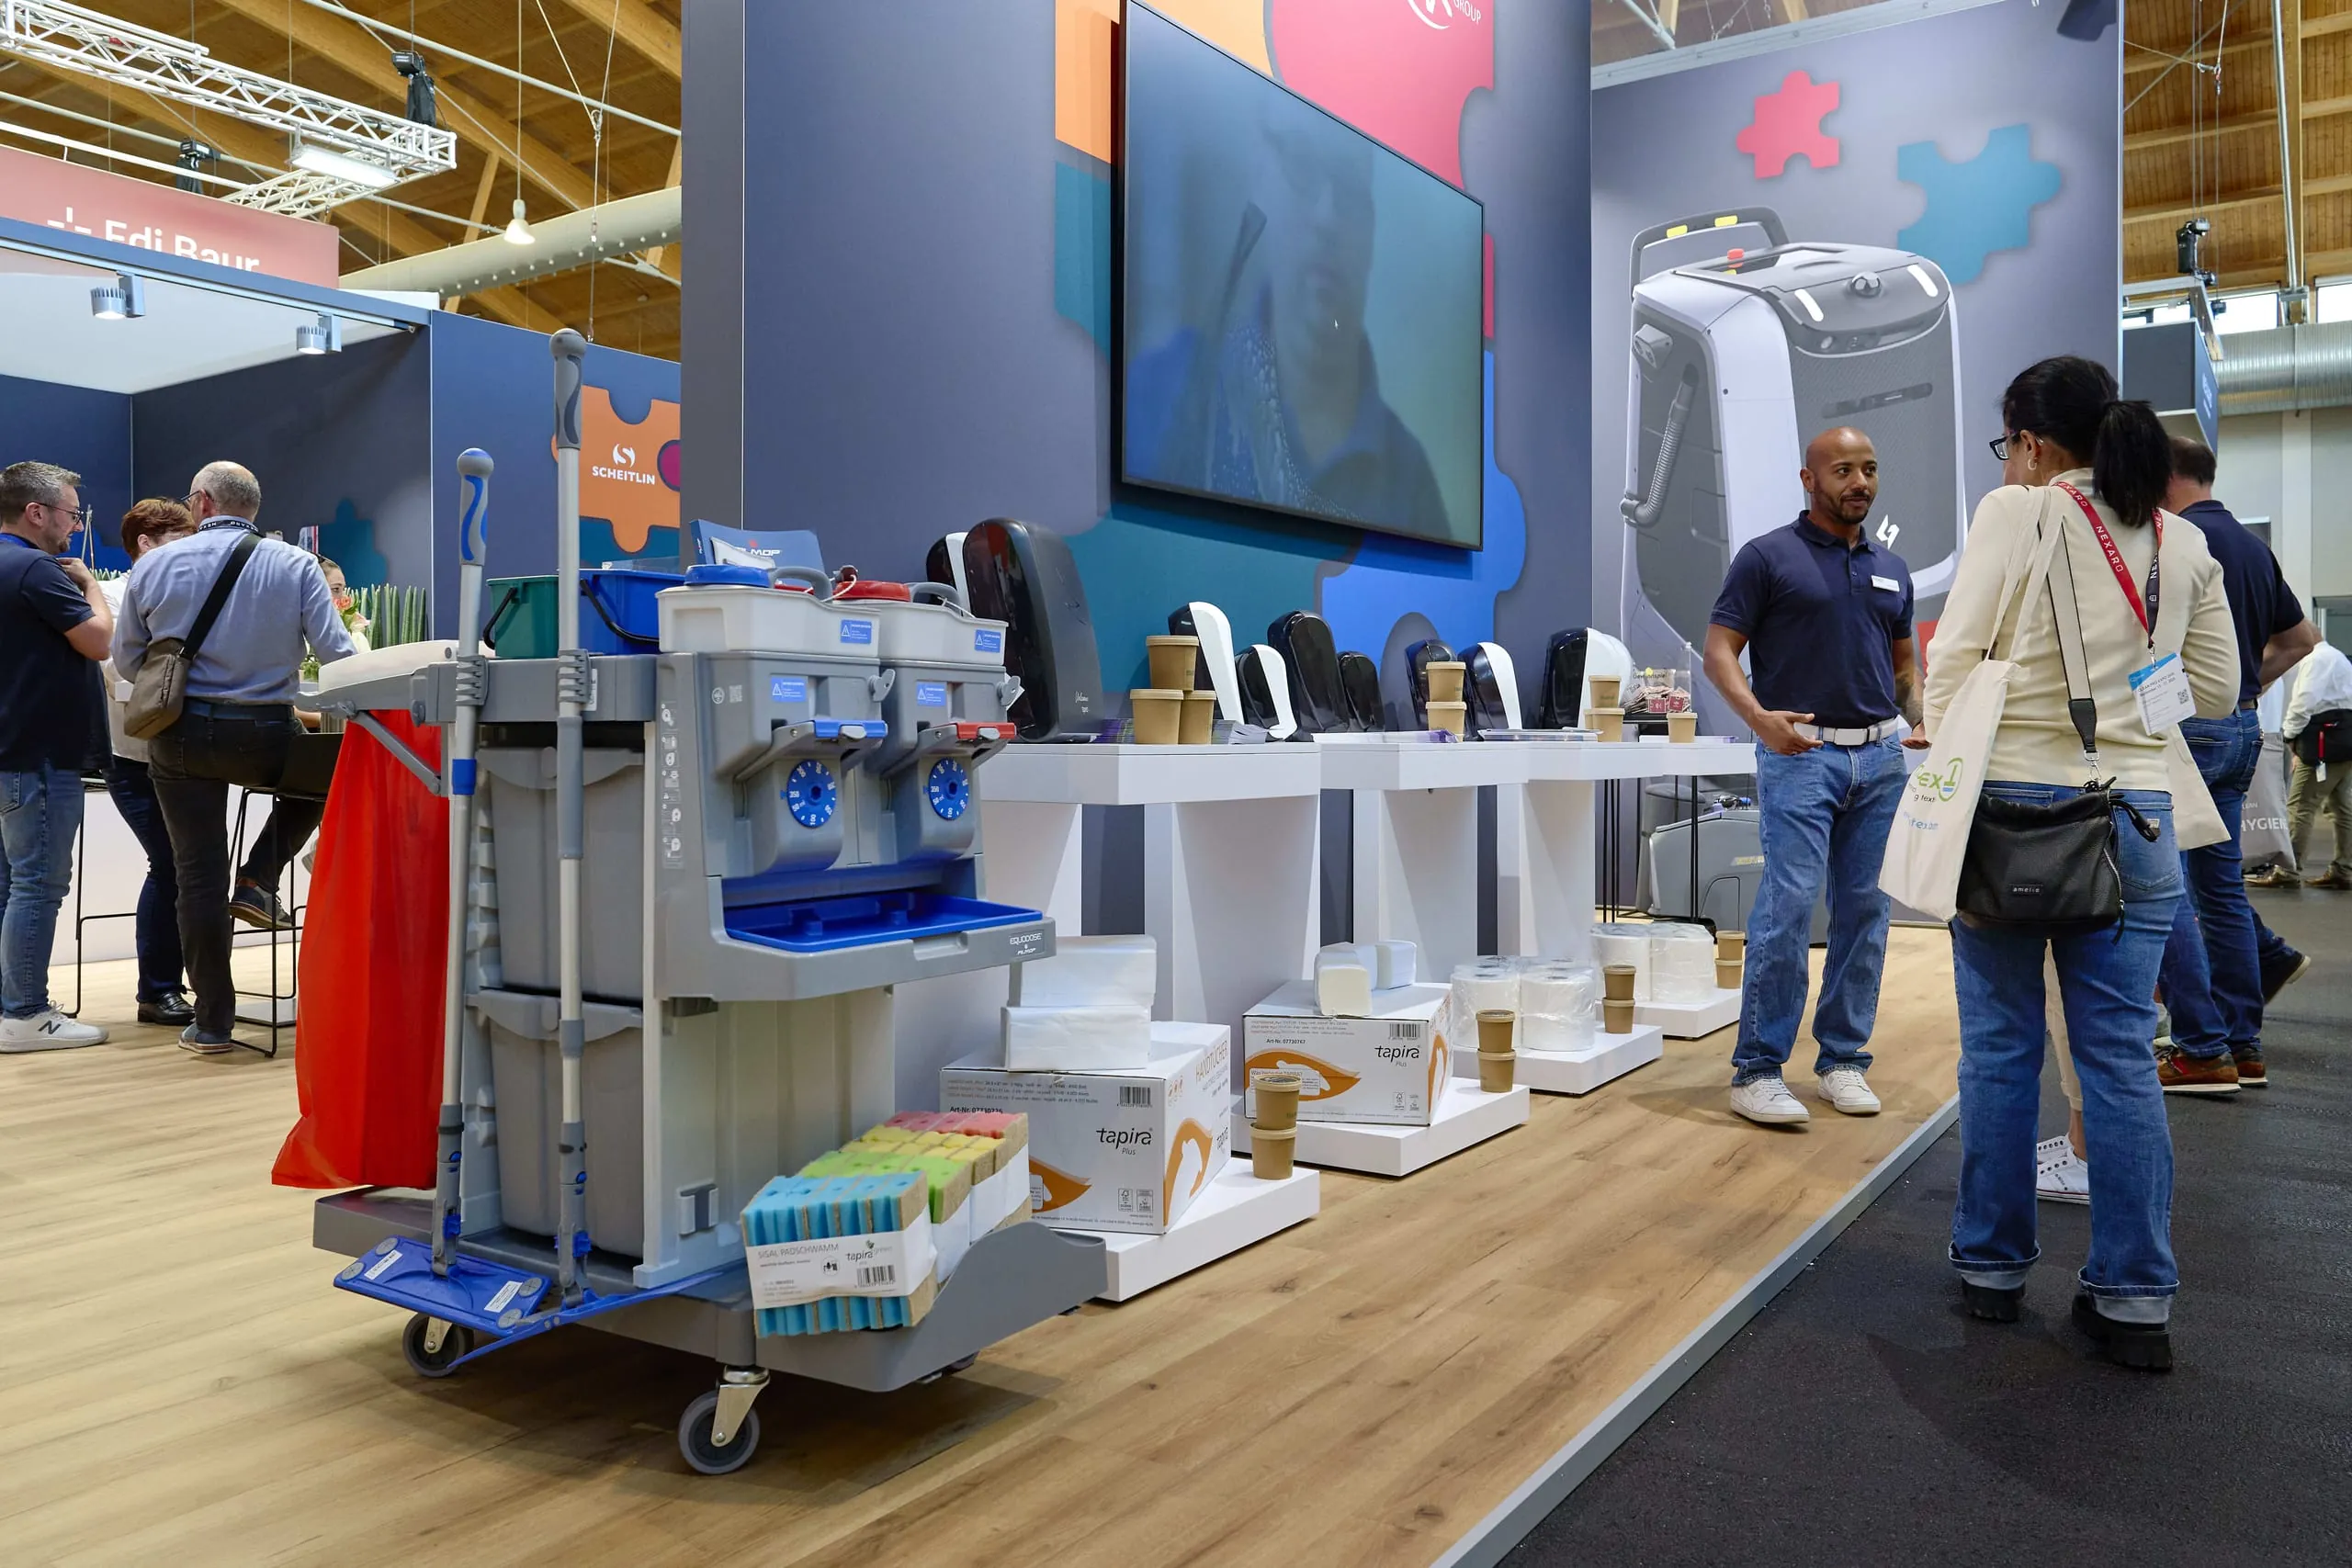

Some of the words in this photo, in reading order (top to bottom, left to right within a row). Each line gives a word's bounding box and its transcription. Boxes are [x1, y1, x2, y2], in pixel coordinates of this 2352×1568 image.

[592, 466, 655, 485] SCHEITLIN
[2096, 525, 2124, 572] NEXARO
[1374, 1045, 1419, 1063] tapira
[1096, 1127, 1152, 1150] tapira
[1122, 1147, 1136, 1156] Plus
[846, 1249, 874, 1263] tapira
